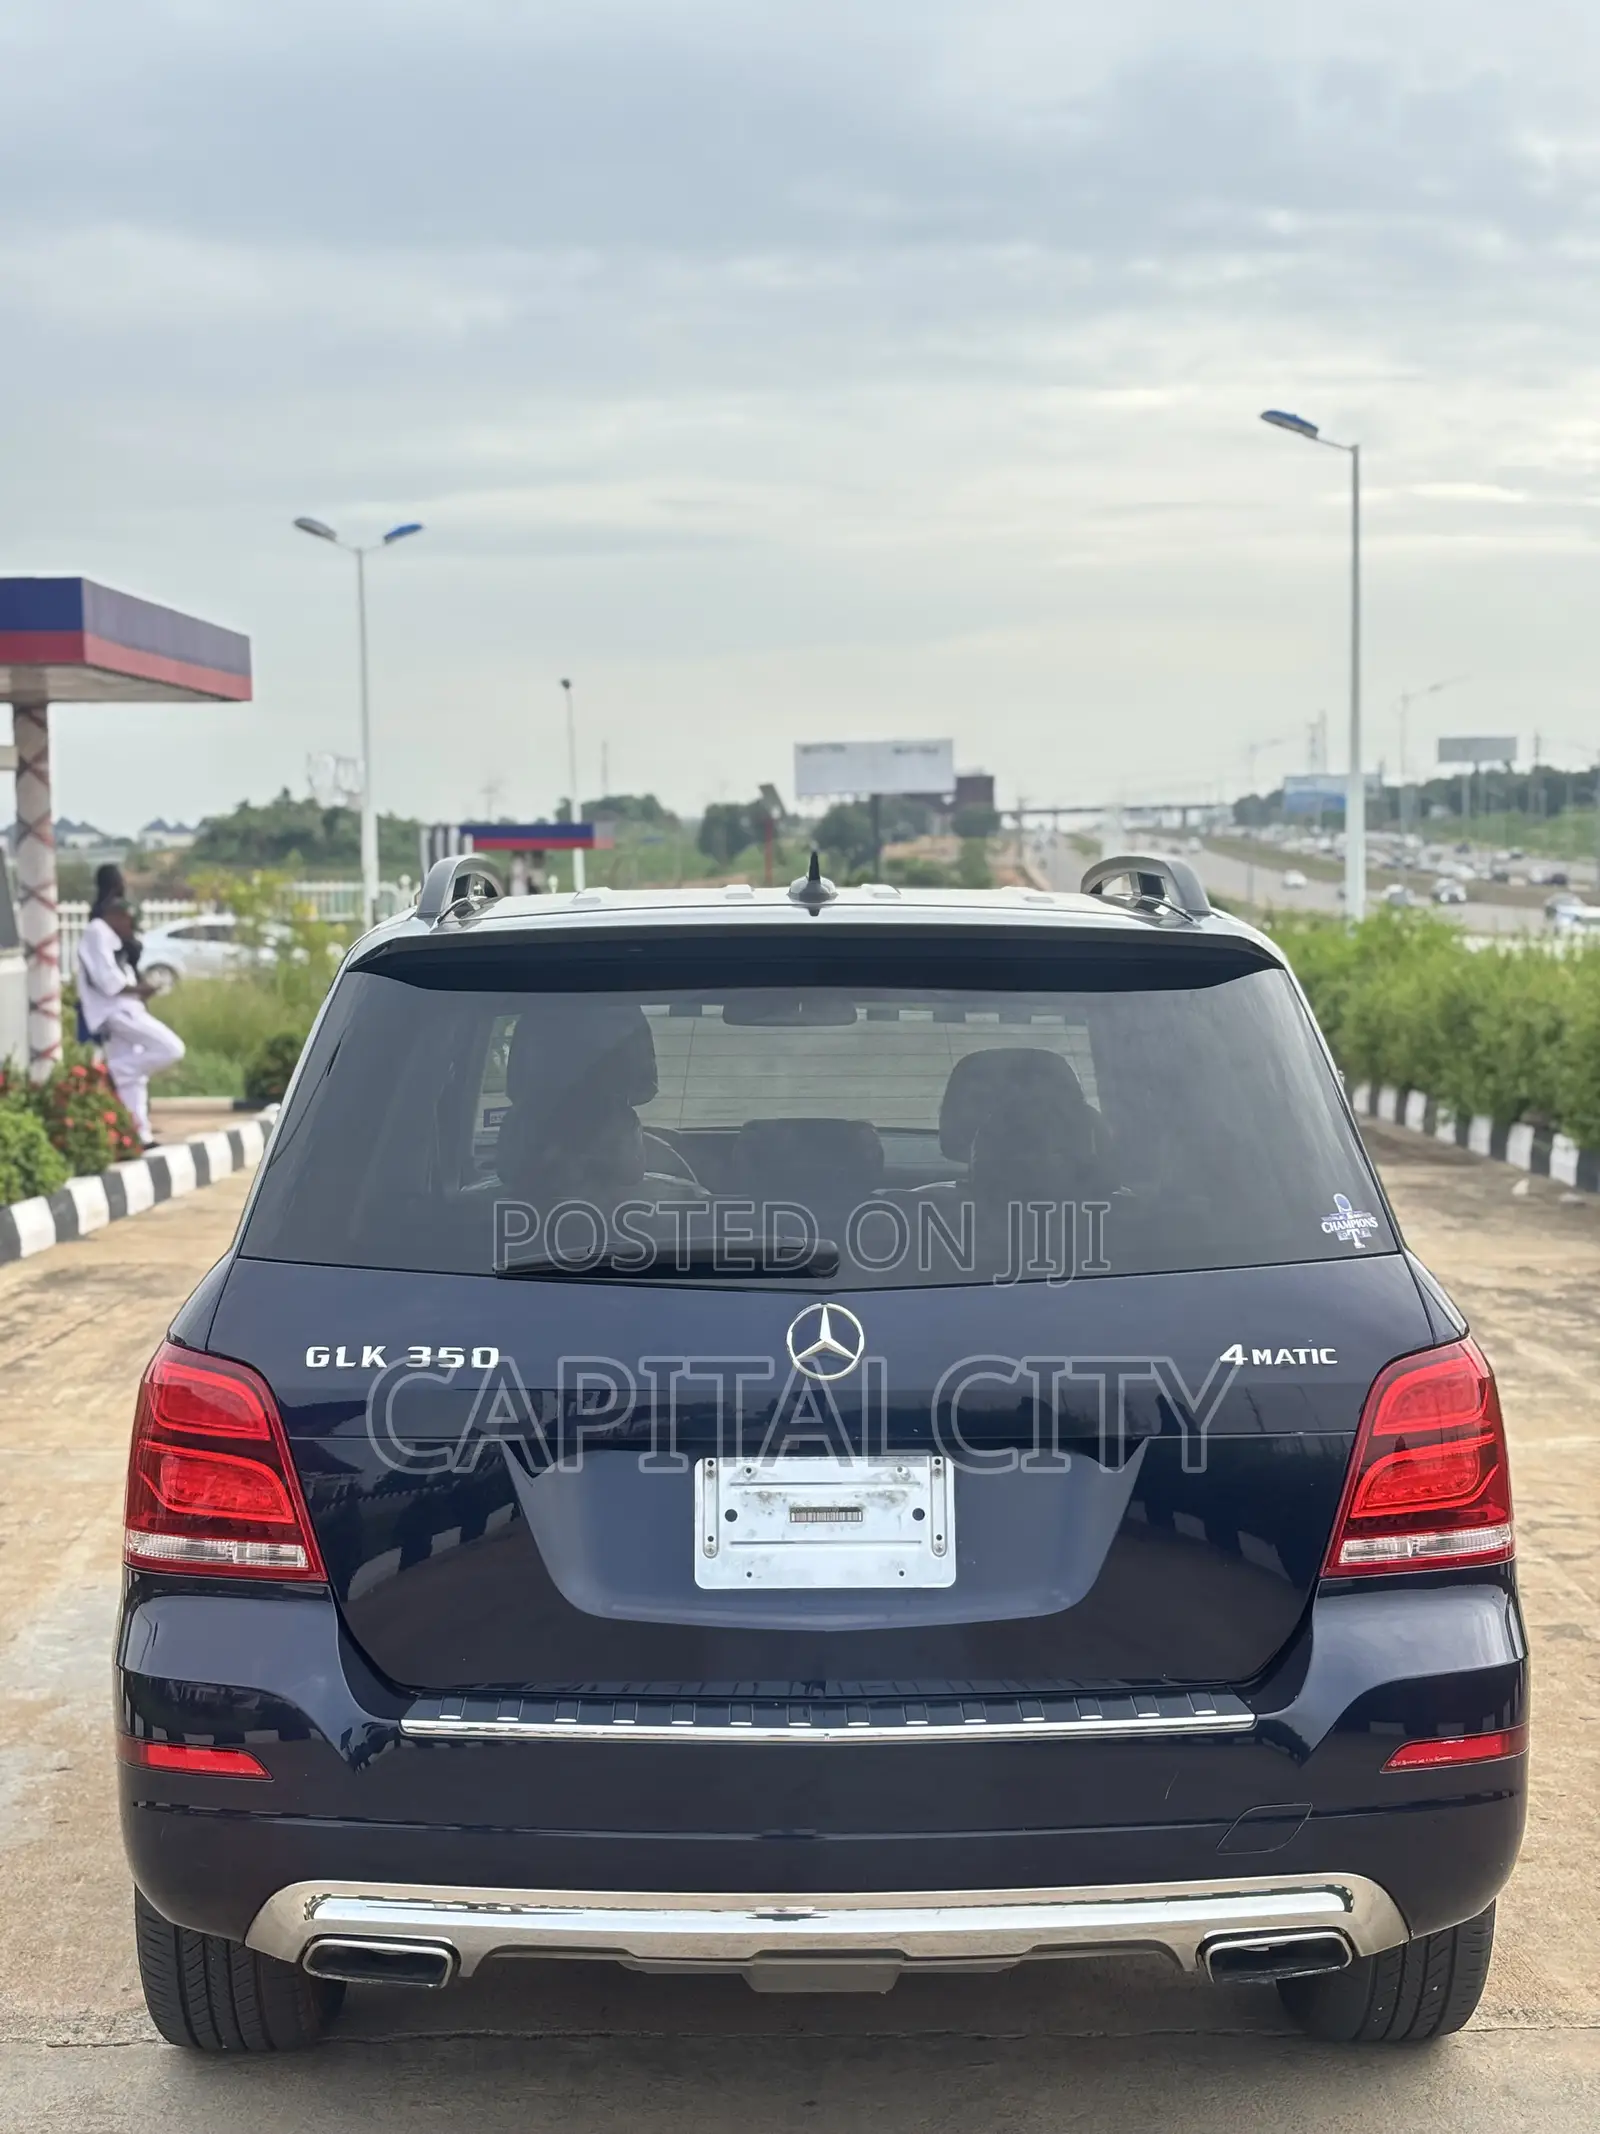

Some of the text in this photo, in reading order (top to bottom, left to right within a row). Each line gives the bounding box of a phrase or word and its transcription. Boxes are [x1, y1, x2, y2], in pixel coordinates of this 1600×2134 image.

[1321, 1216, 1379, 1234] CHAMPIONS
[305, 1345, 500, 1369] GLK 350
[1219, 1343, 1339, 1366] 4MATIC
